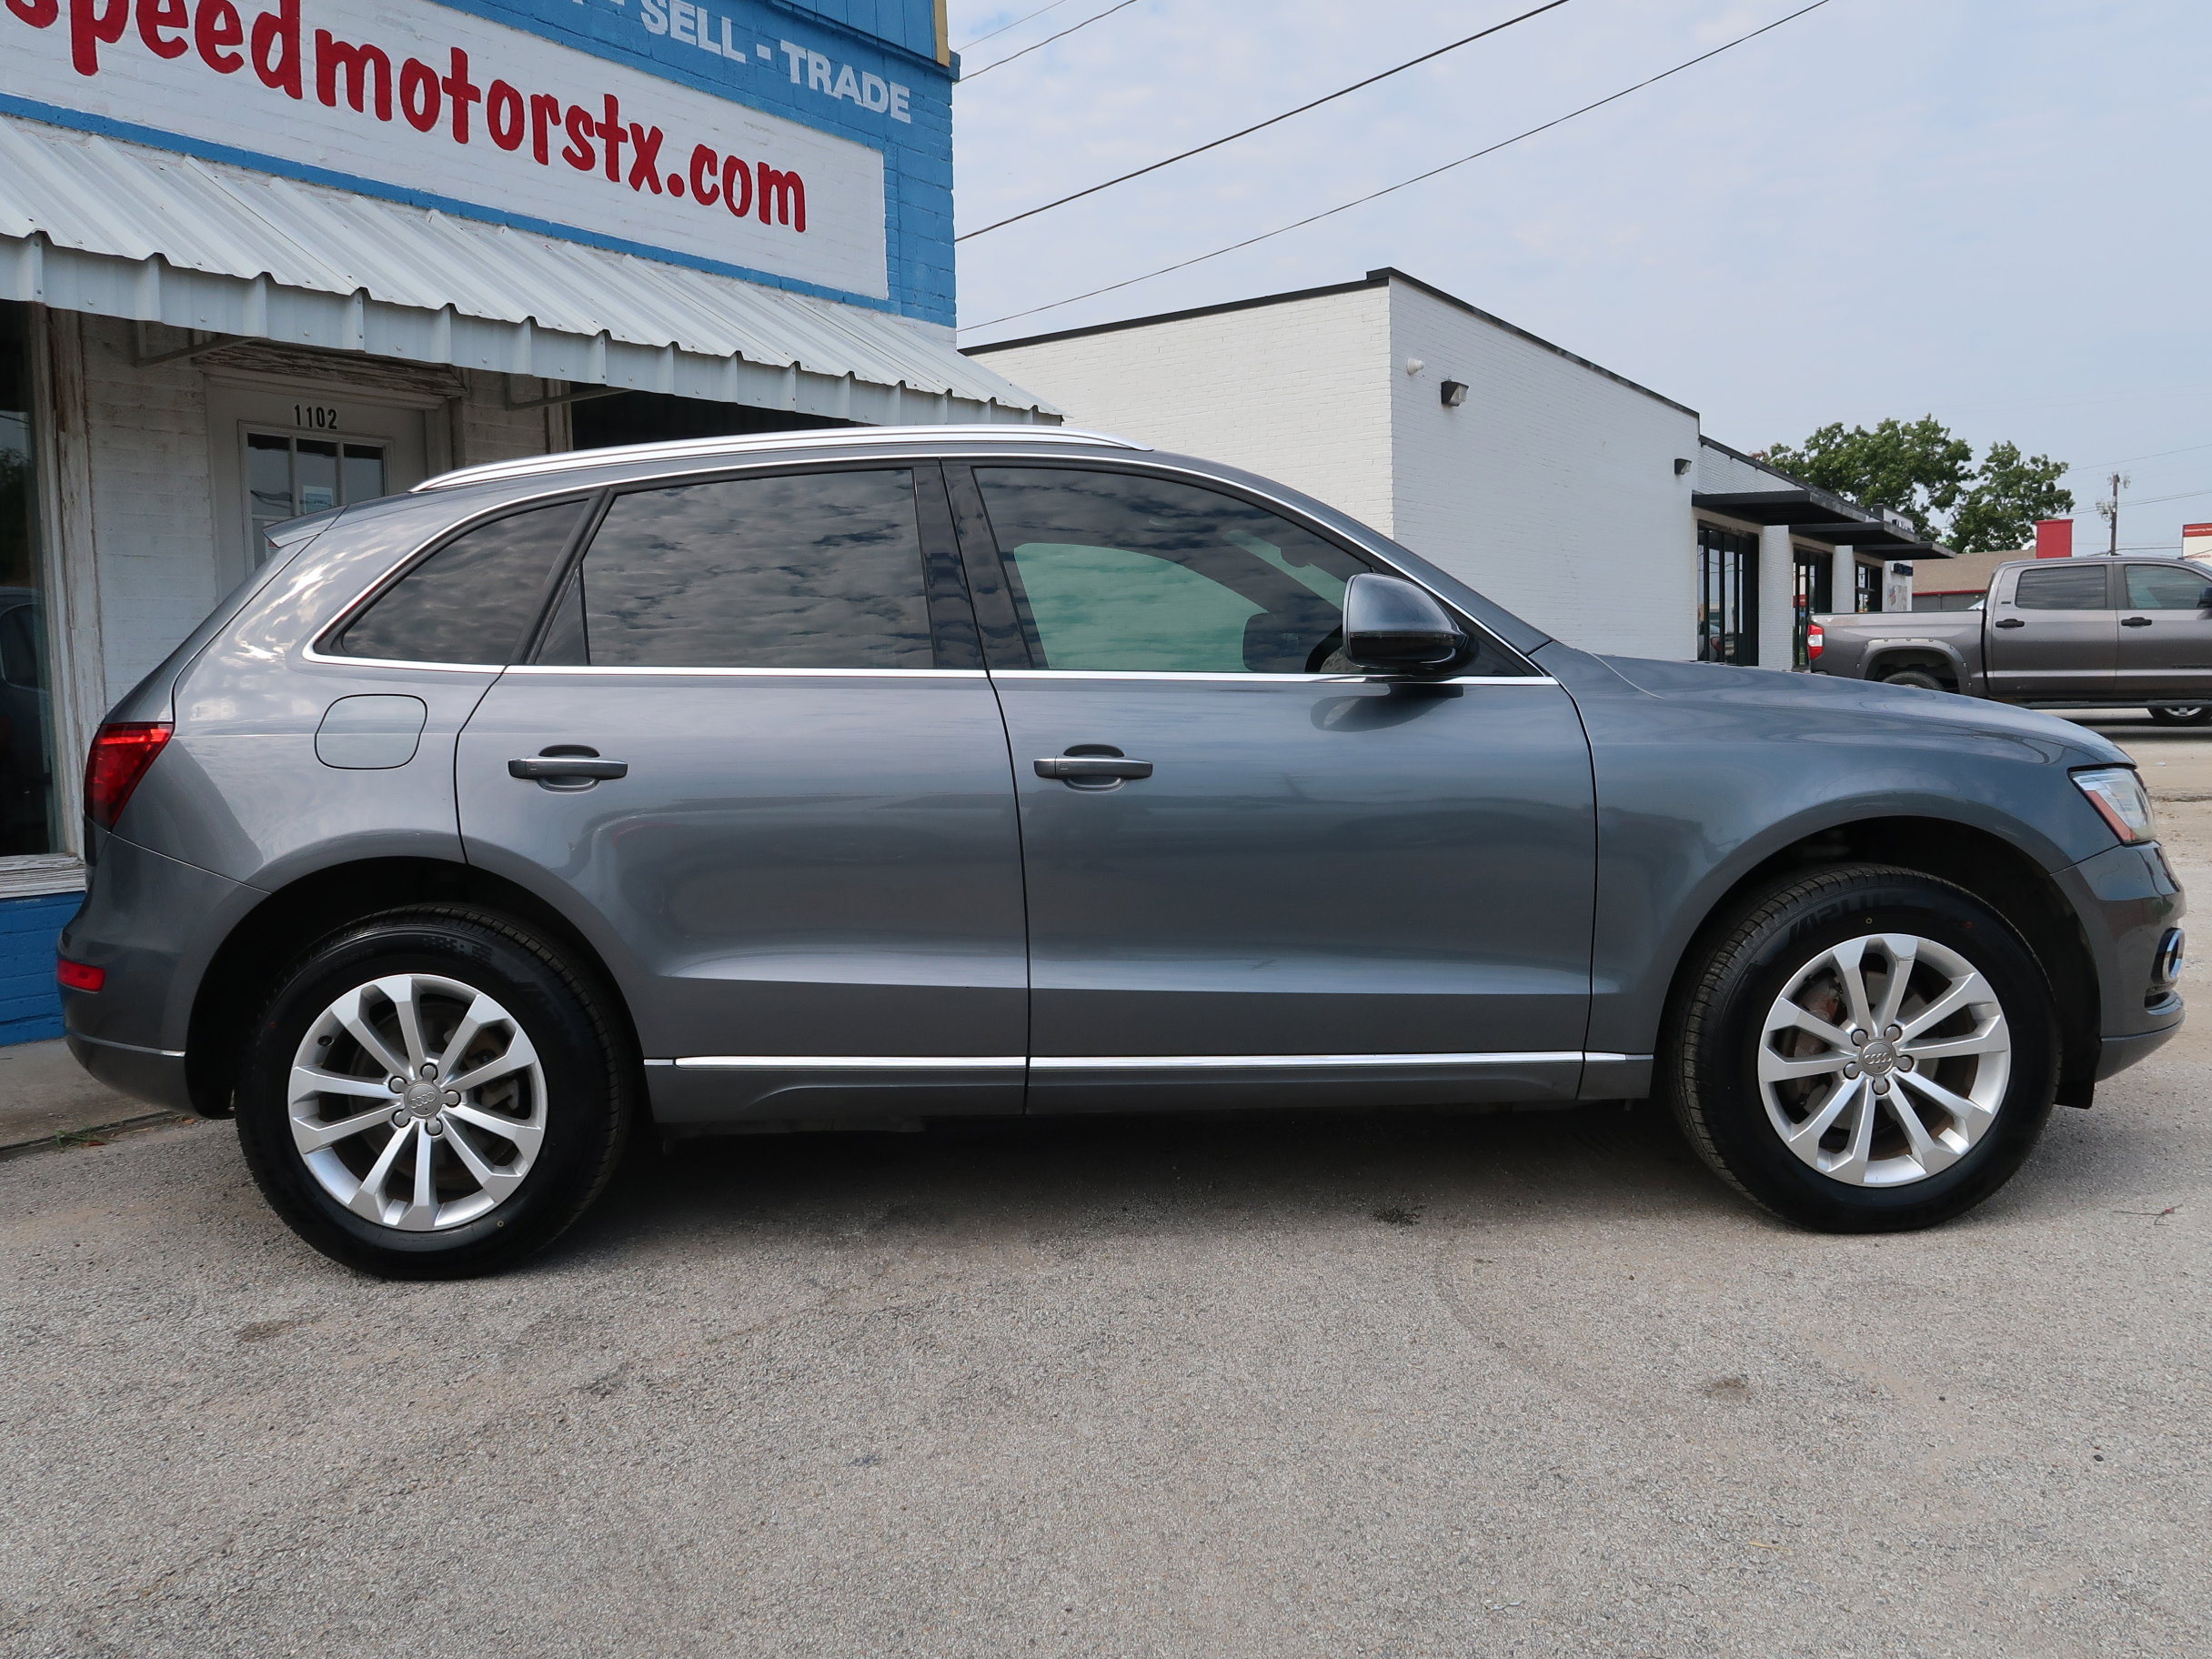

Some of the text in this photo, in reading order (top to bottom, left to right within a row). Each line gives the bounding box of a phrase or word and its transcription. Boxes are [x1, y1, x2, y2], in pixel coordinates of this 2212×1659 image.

[640, 0, 746, 64] SELL
[779, 39, 911, 124] TRADE
[294, 404, 337, 430] 1102
